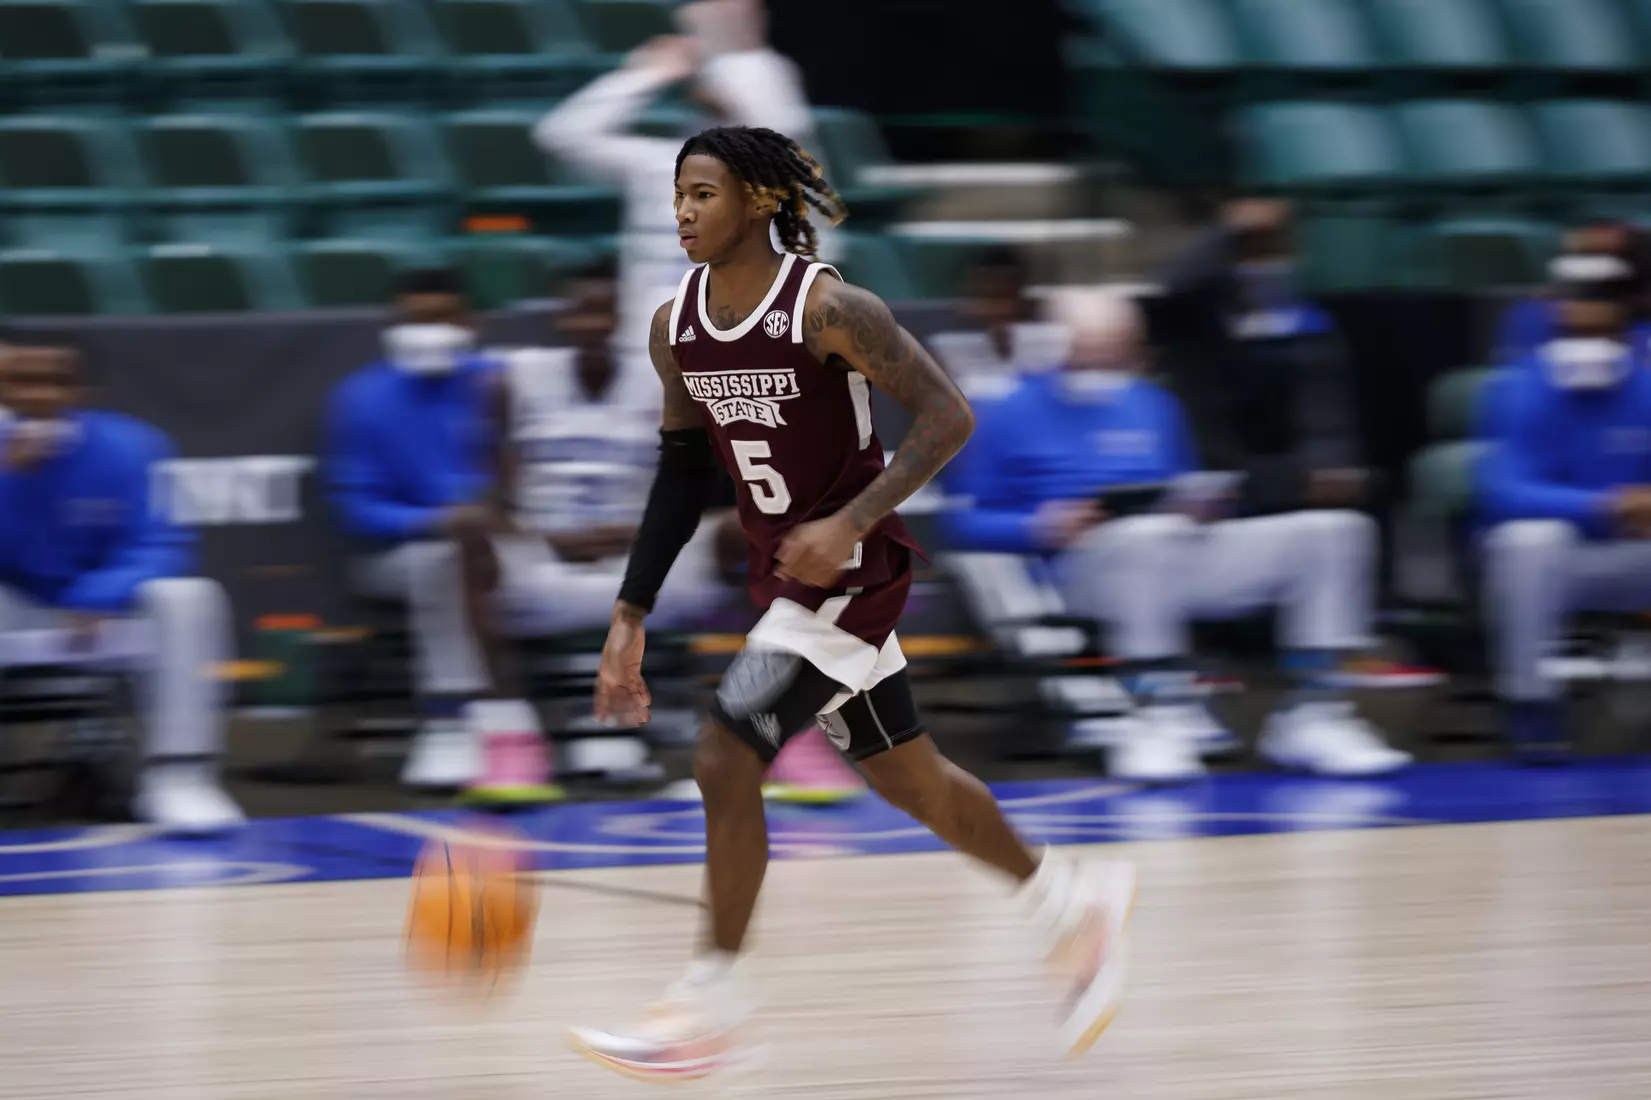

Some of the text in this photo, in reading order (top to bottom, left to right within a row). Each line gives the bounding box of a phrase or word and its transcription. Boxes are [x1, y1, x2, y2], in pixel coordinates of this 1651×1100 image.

[765, 312, 787, 336] SEC
[678, 334, 697, 342] adidas
[683, 372, 800, 398] MISSISSIPPI
[716, 400, 768, 422] STATE
[730, 440, 792, 515] 5
